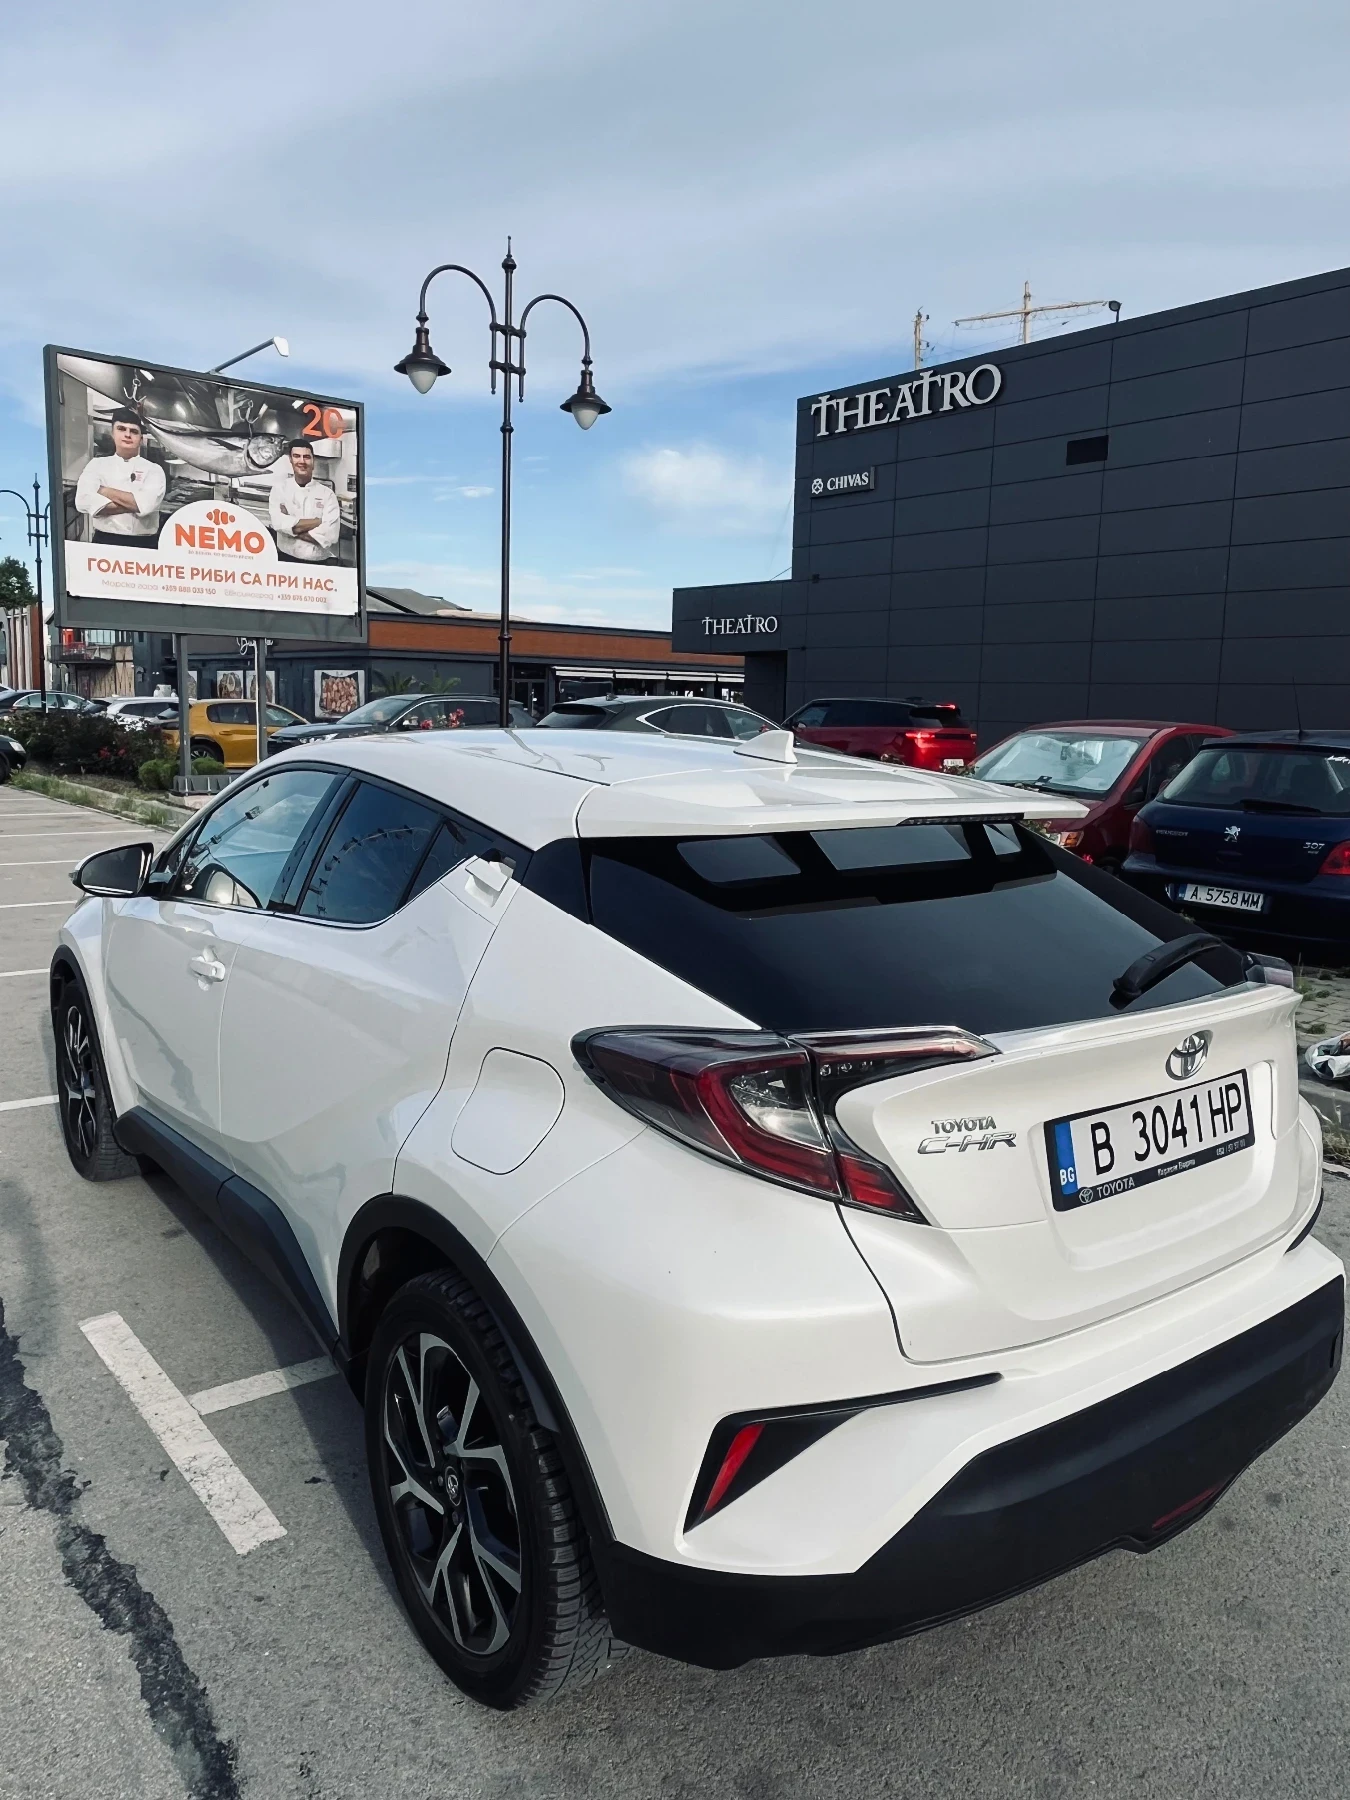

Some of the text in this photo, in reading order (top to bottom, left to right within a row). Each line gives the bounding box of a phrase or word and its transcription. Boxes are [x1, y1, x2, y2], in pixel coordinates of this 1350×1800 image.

[810, 363, 1002, 437] THEATRO
[826, 472, 869, 491] CHIVAS
[175, 523, 265, 554] NEMO
[87, 557, 338, 593] ГОЛЕМИТЕ РИБИ СА ПРИ НАС.
[701, 614, 778, 635] THEATRO
[1302, 842, 1325, 850] 307
[1205, 888, 1239, 906] 5758
[1240, 892, 1262, 910] MM
[930, 1116, 997, 1135] TOYOTA
[1090, 1082, 1242, 1176] B 3041 HP
[917, 1131, 1017, 1155] C-HR
[1059, 1167, 1075, 1186] BG
[1096, 1176, 1136, 1199] TOYOTA
